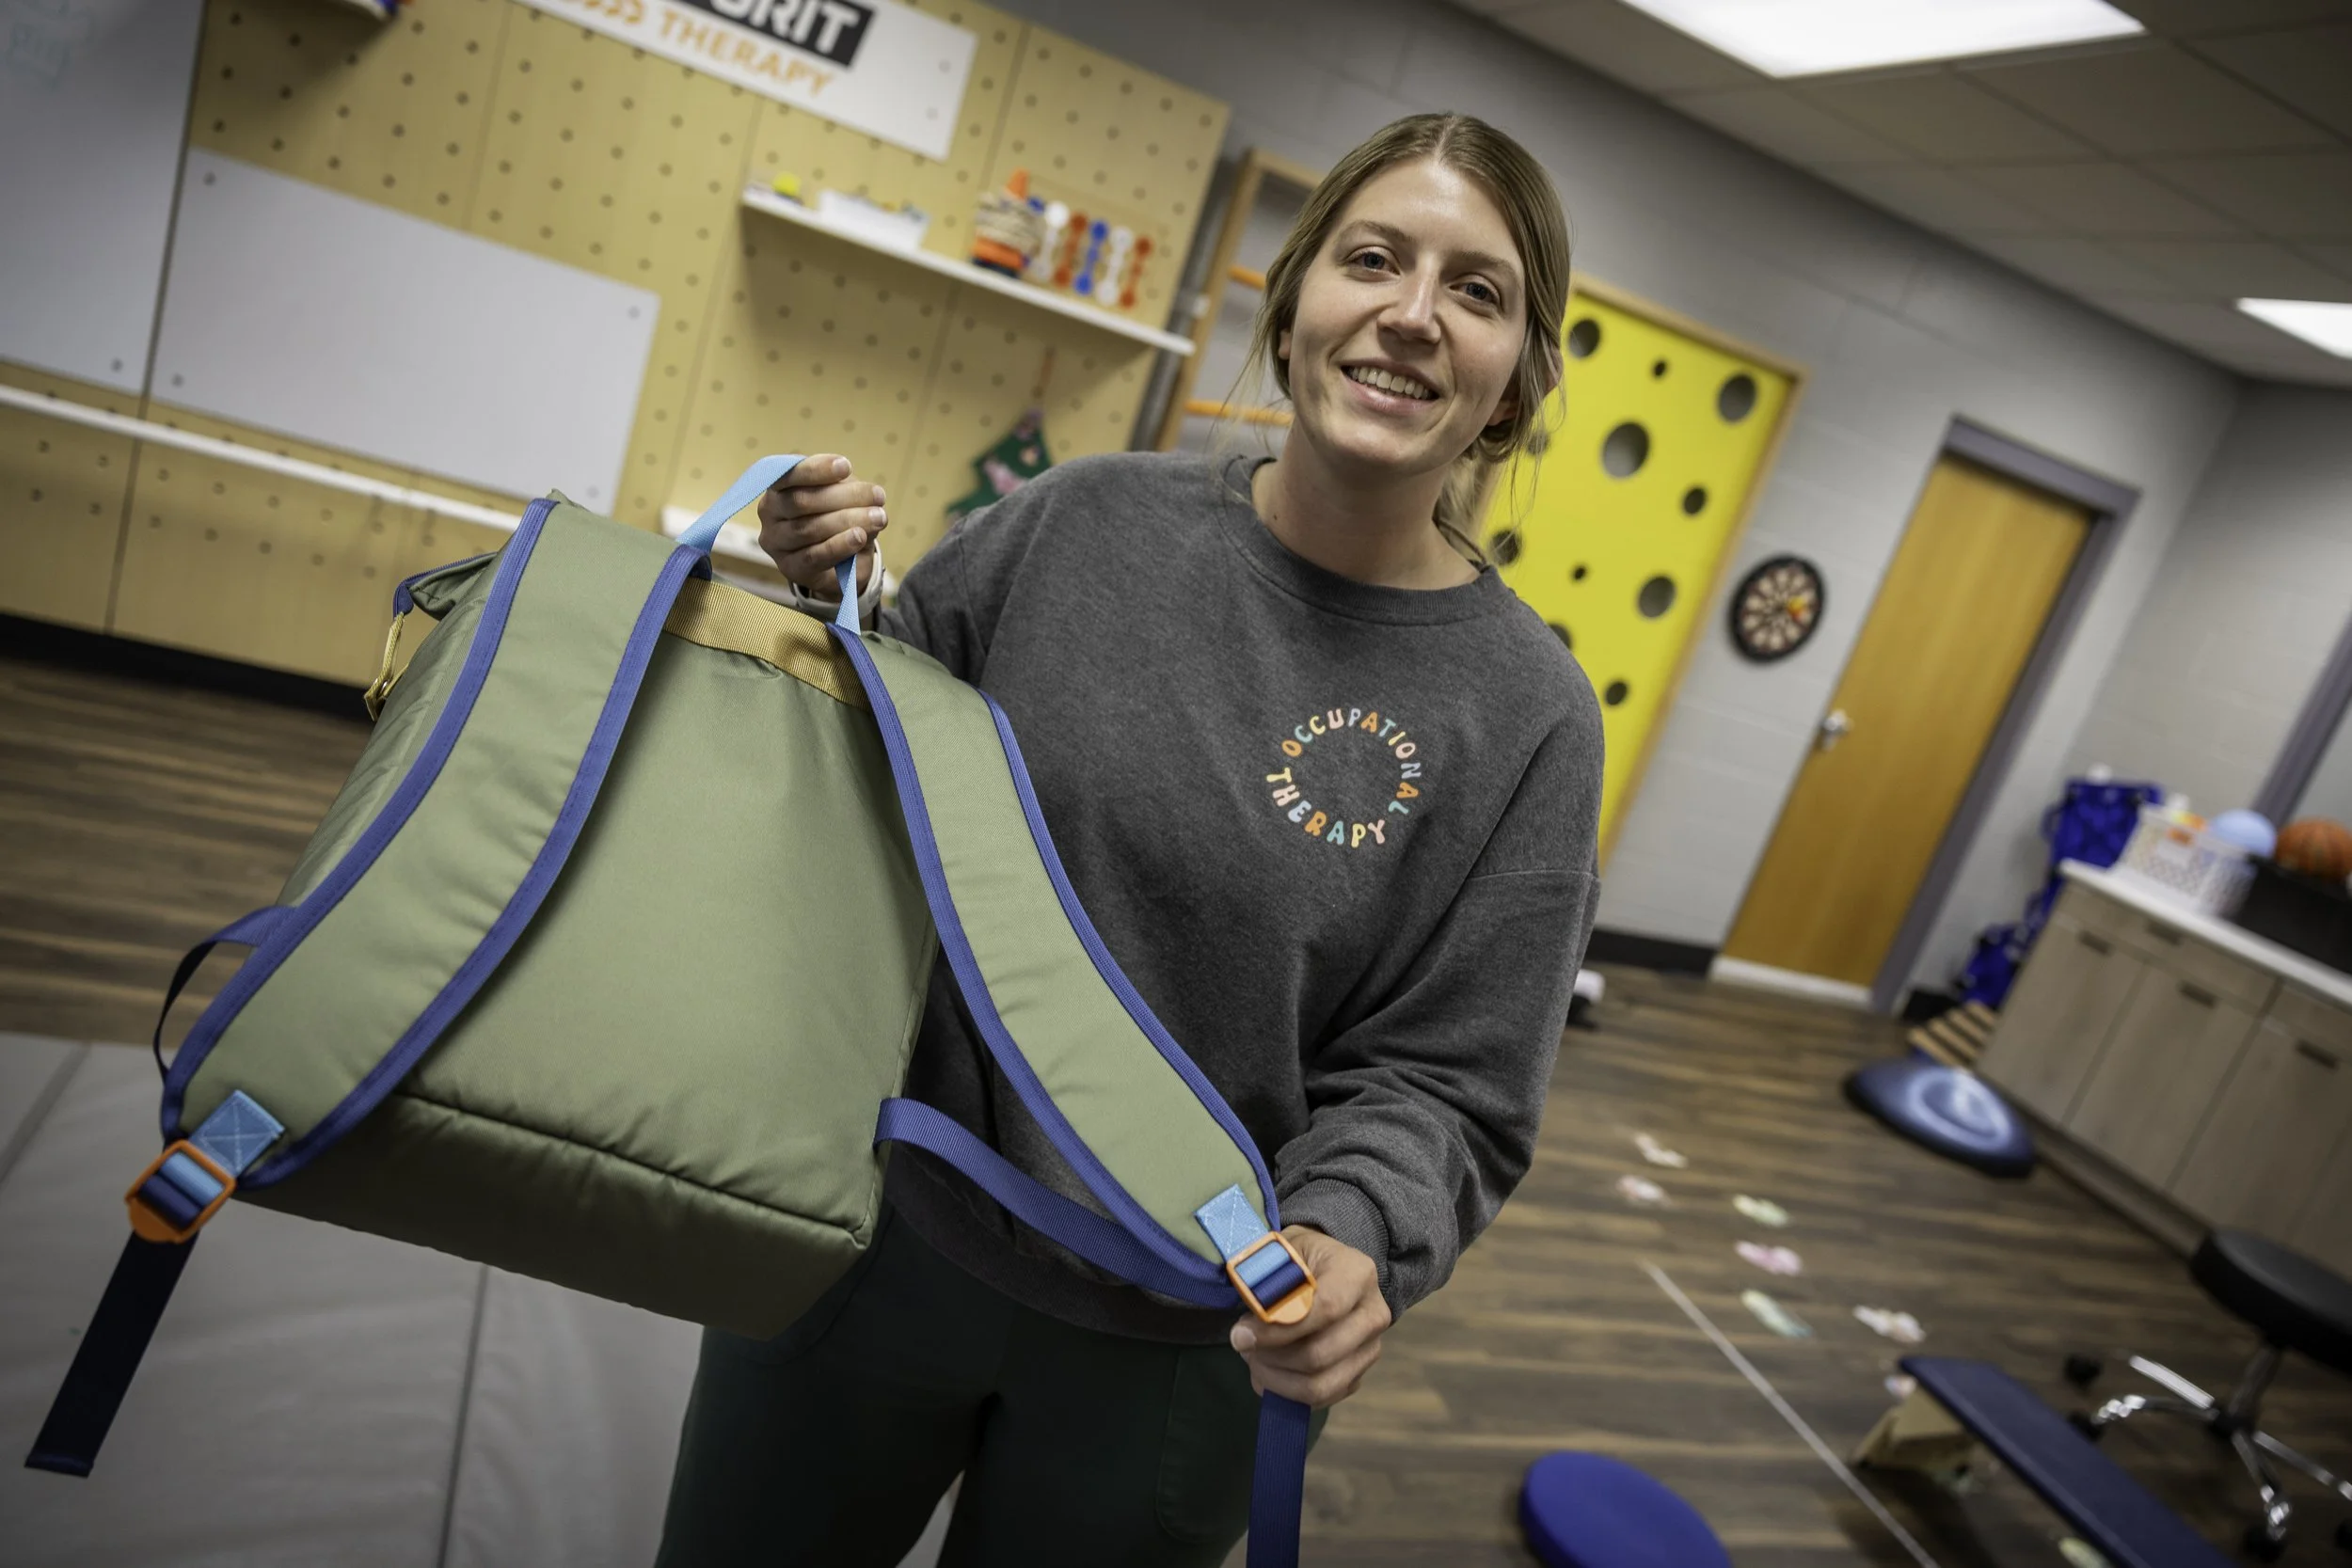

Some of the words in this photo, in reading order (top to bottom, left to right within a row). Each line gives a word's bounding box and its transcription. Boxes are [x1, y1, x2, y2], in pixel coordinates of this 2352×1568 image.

[661, 9, 834, 97] THERAPY
[1281, 707, 1422, 815] OCCUPATIONAL
[1266, 767, 1386, 848] THERAPY
